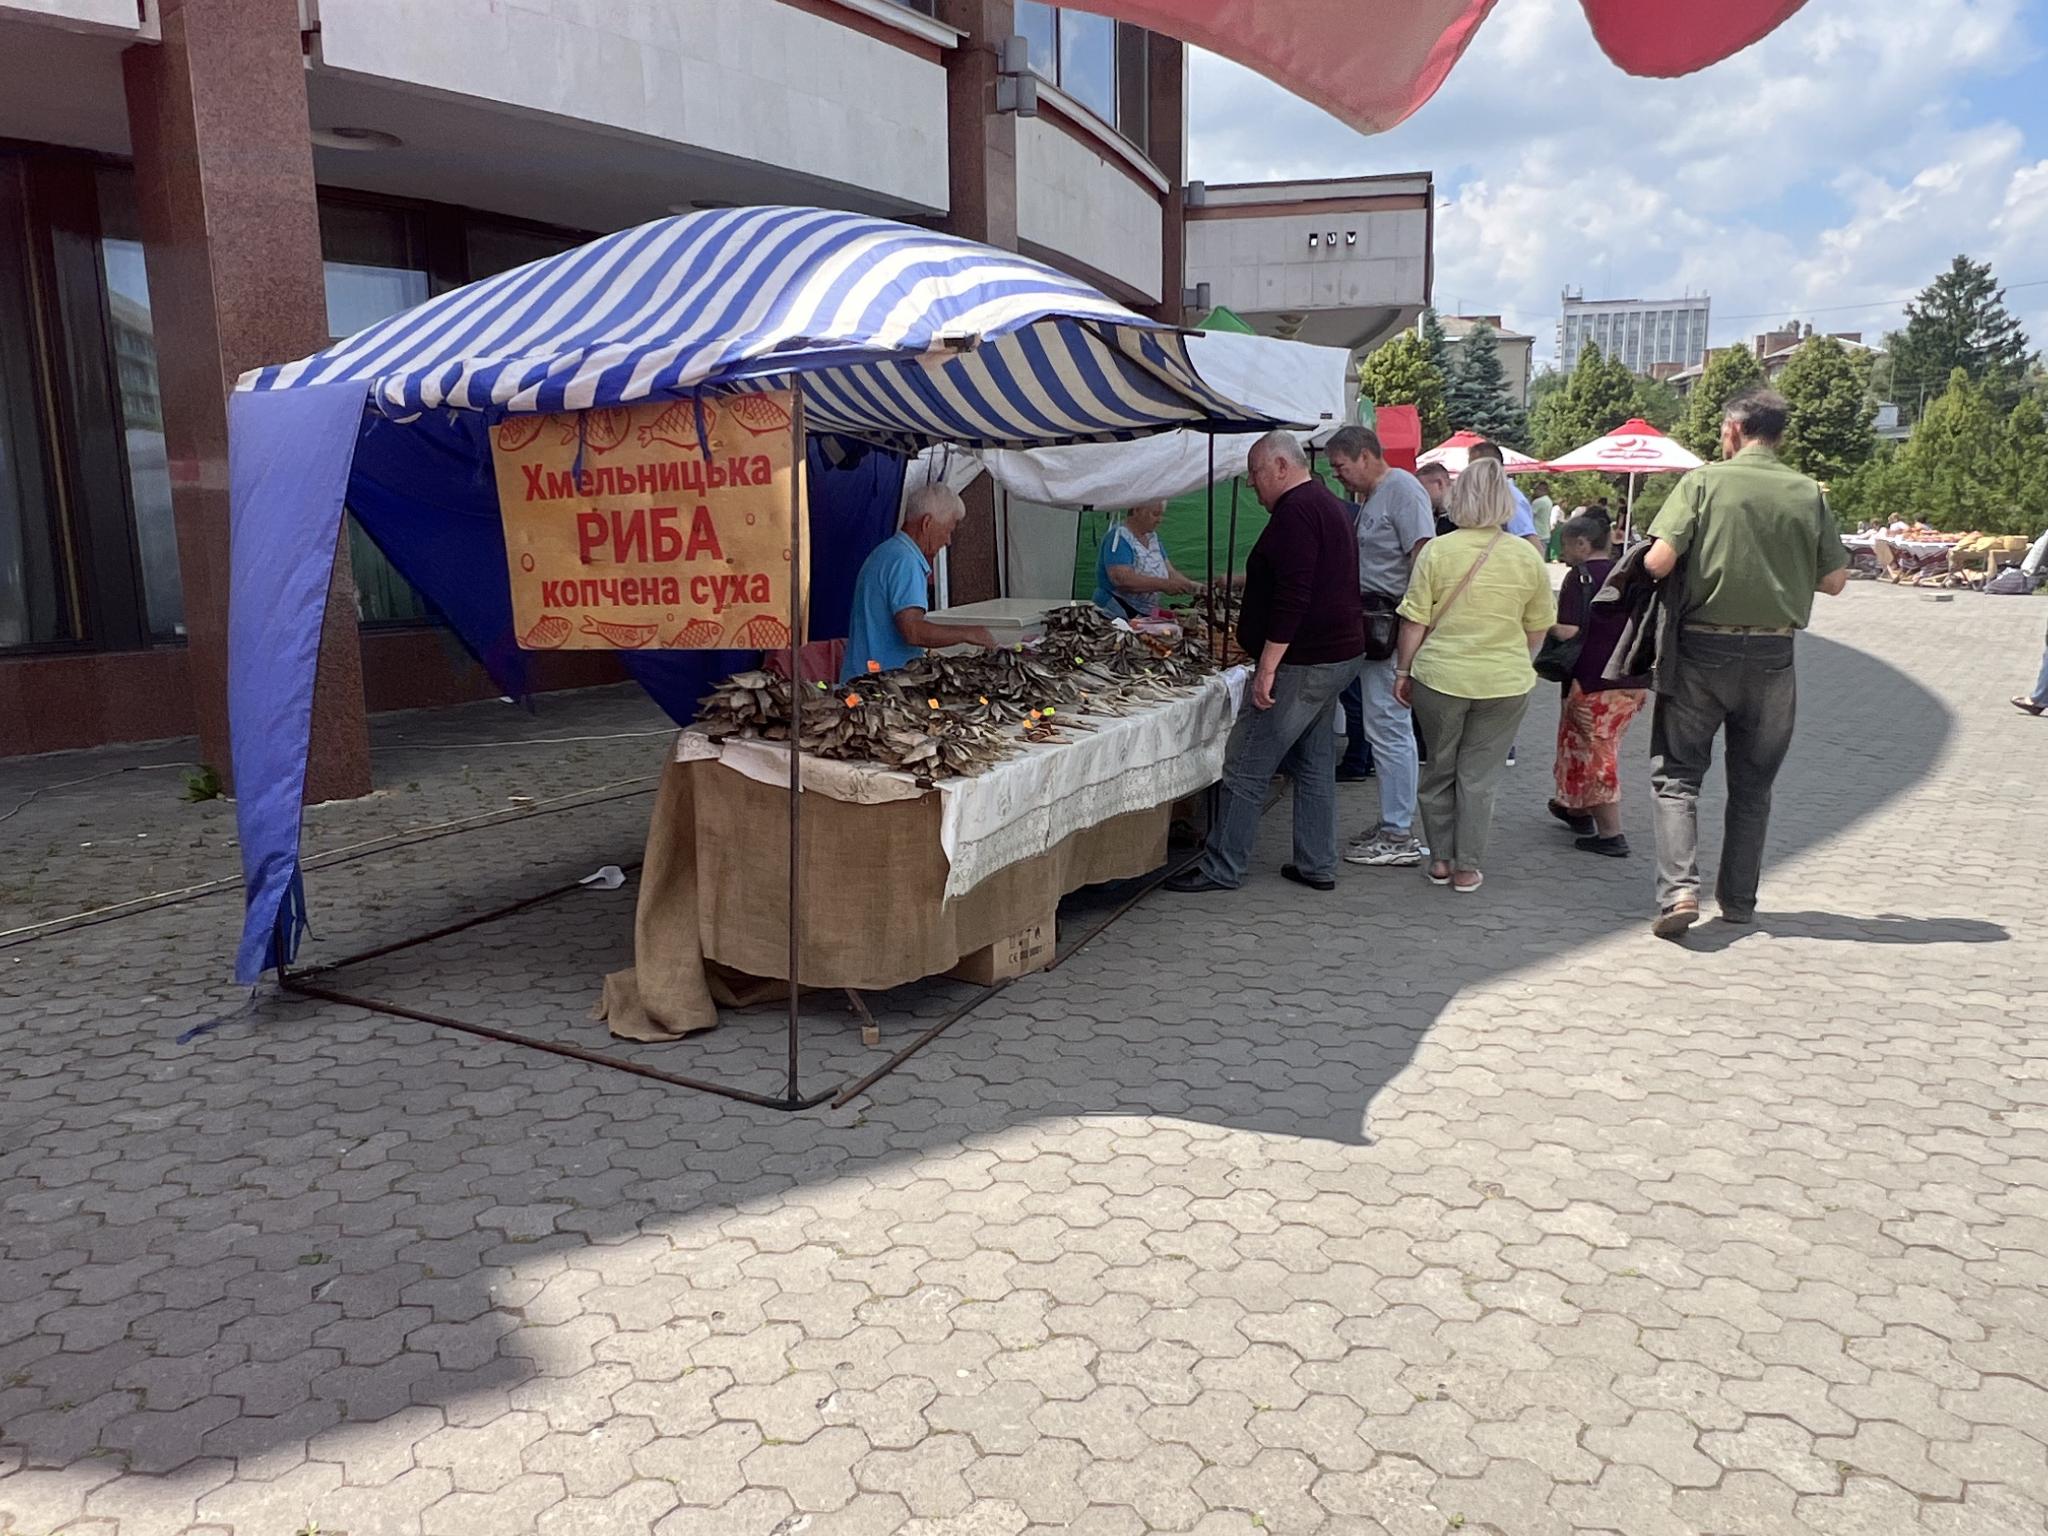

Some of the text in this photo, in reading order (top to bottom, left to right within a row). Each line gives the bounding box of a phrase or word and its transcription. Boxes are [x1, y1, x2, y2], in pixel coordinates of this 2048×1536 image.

[522, 454, 772, 502] Хмельницька
[576, 504, 725, 565] РИБА
[541, 572, 770, 615] копчена суха
